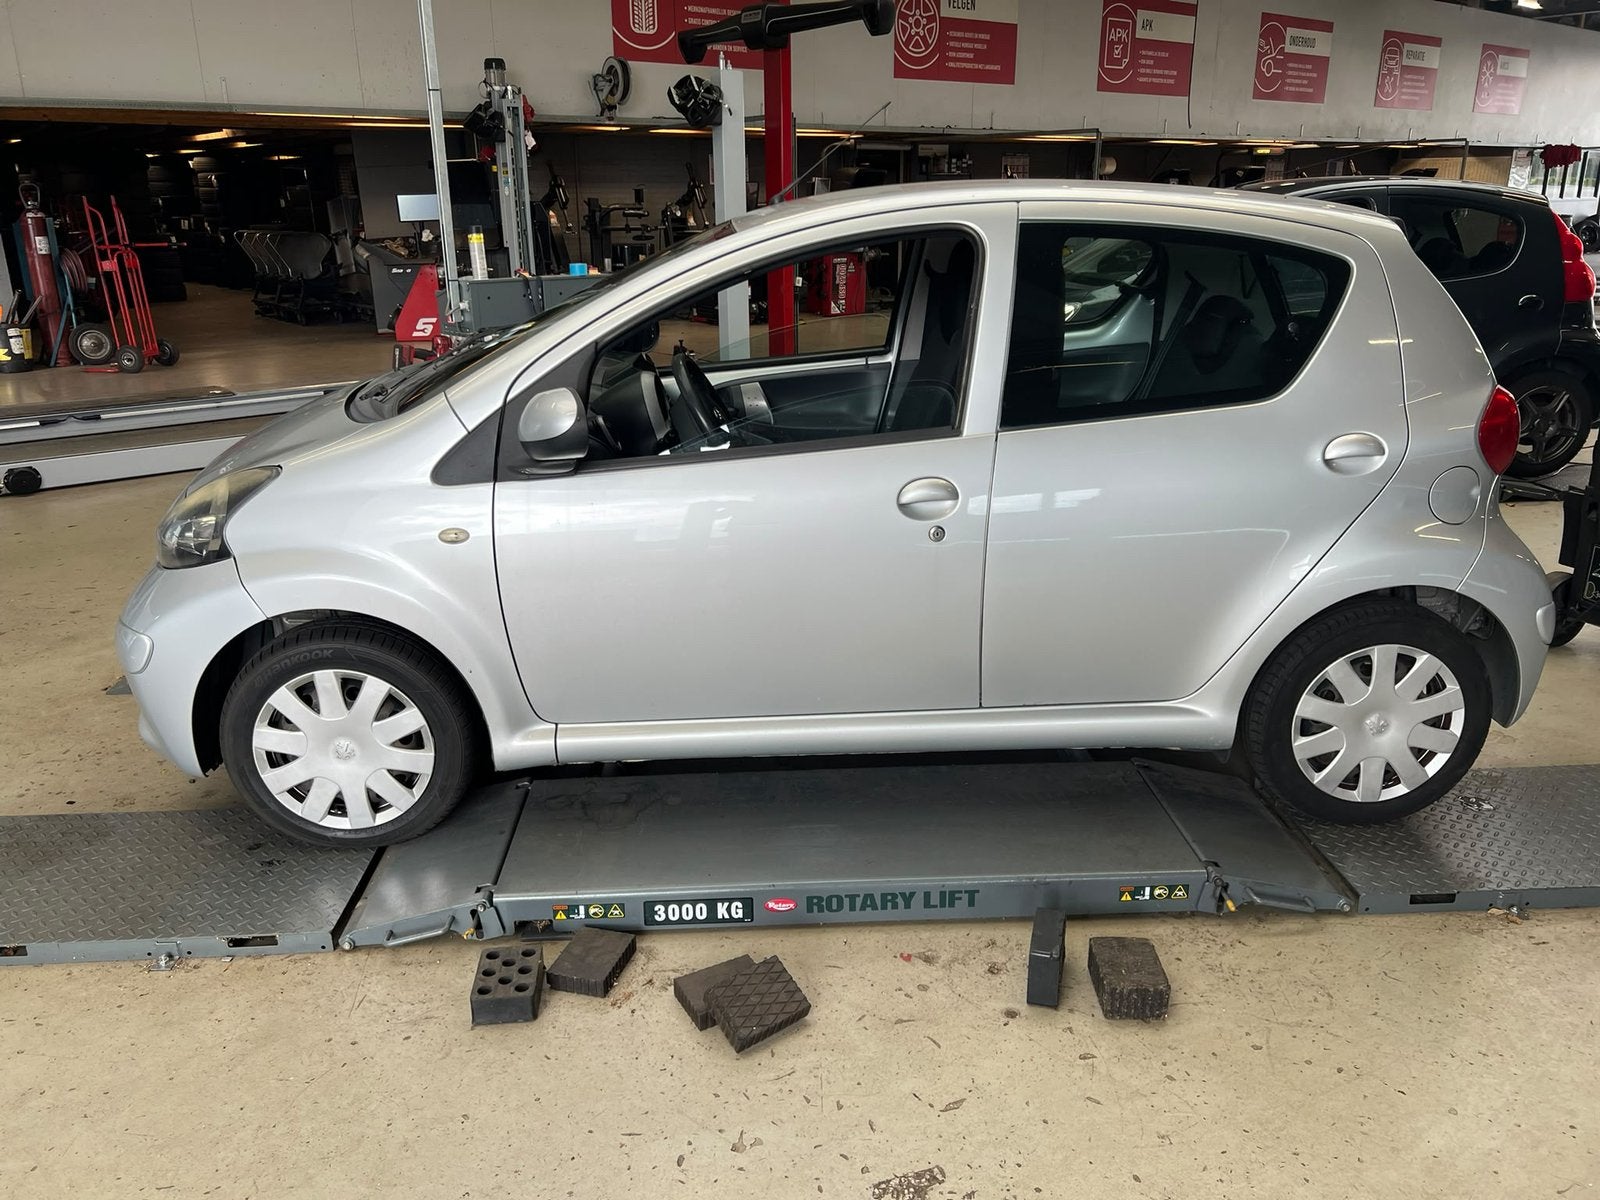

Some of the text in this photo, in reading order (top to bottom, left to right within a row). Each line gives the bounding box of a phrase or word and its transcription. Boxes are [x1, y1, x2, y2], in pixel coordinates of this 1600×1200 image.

[947, 0, 976, 11] VELGEN
[1141, 18, 1153, 31] APK
[1109, 28, 1129, 42] APK
[1289, 35, 1316, 48] ONDERHOUD
[767, 901, 796, 910] Rotary
[806, 889, 981, 914] ROTARY LIFT
[653, 901, 745, 922] 3000 KG
